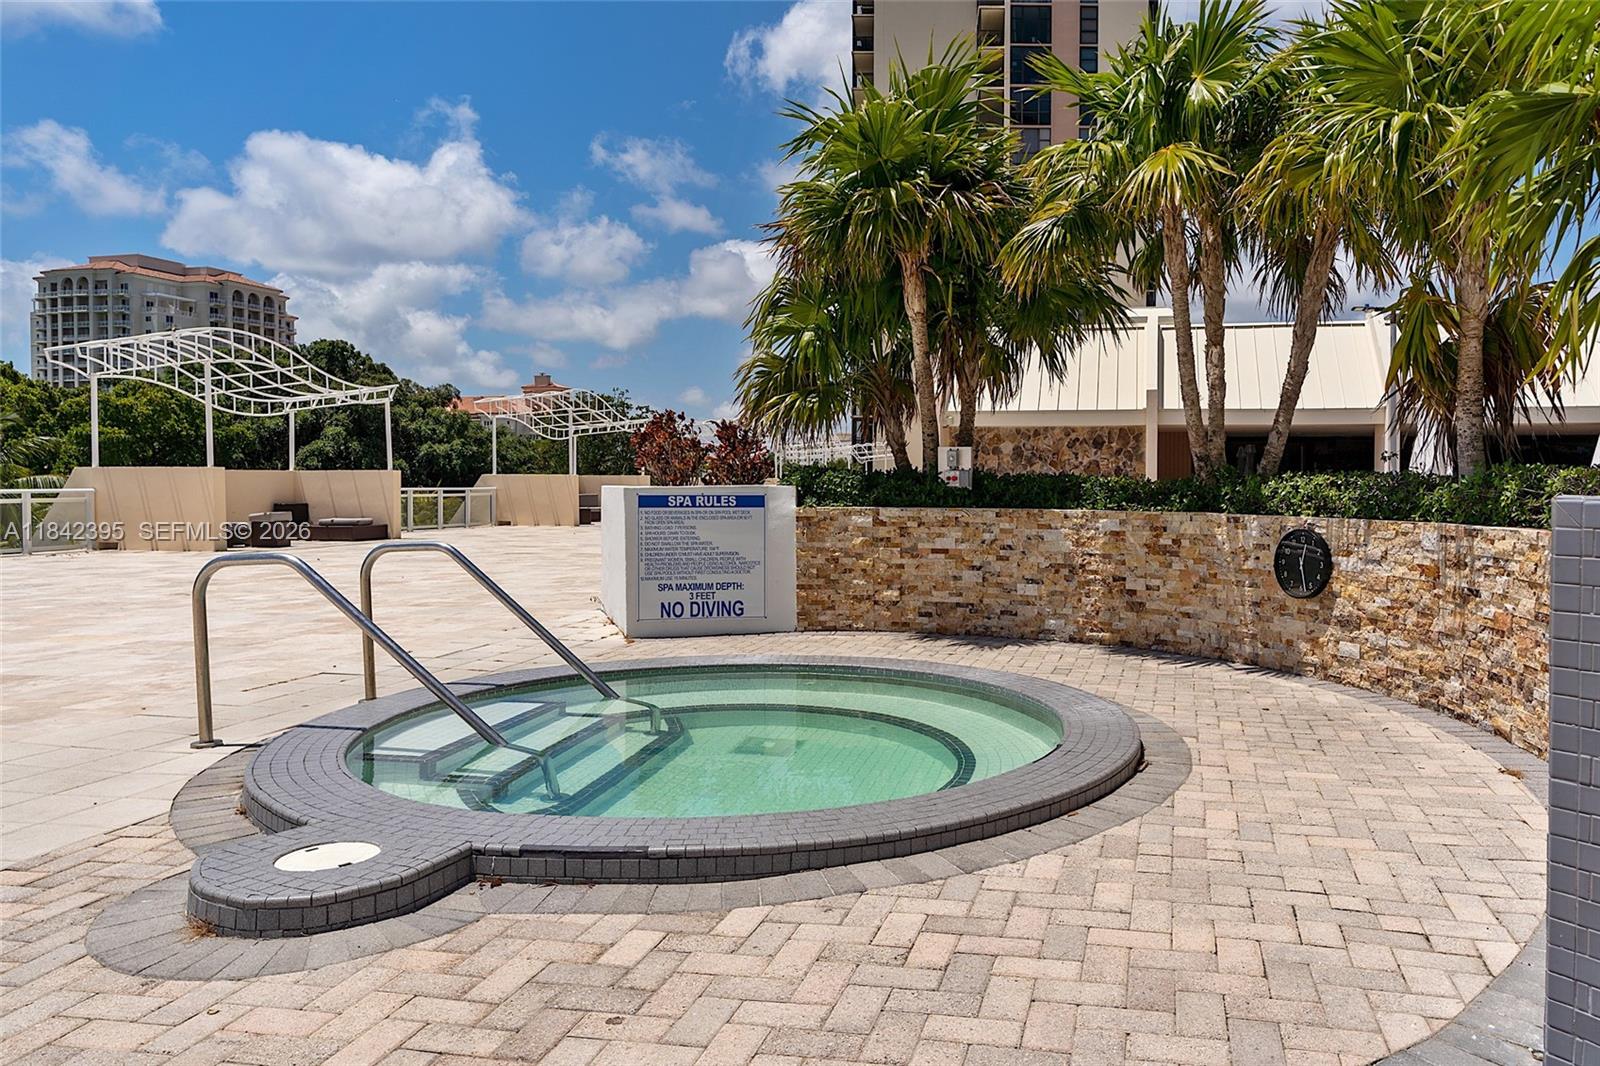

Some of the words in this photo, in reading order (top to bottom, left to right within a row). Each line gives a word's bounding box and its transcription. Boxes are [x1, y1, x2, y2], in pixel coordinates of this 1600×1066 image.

[668, 496, 692, 506] SPA
[696, 496, 736, 506] RULES
[658, 583, 674, 591] SPA
[675, 583, 714, 591] MAXIMUM
[716, 582, 744, 590] DEPTH:
[661, 601, 684, 618] NO
[690, 600, 744, 617] DIVING
